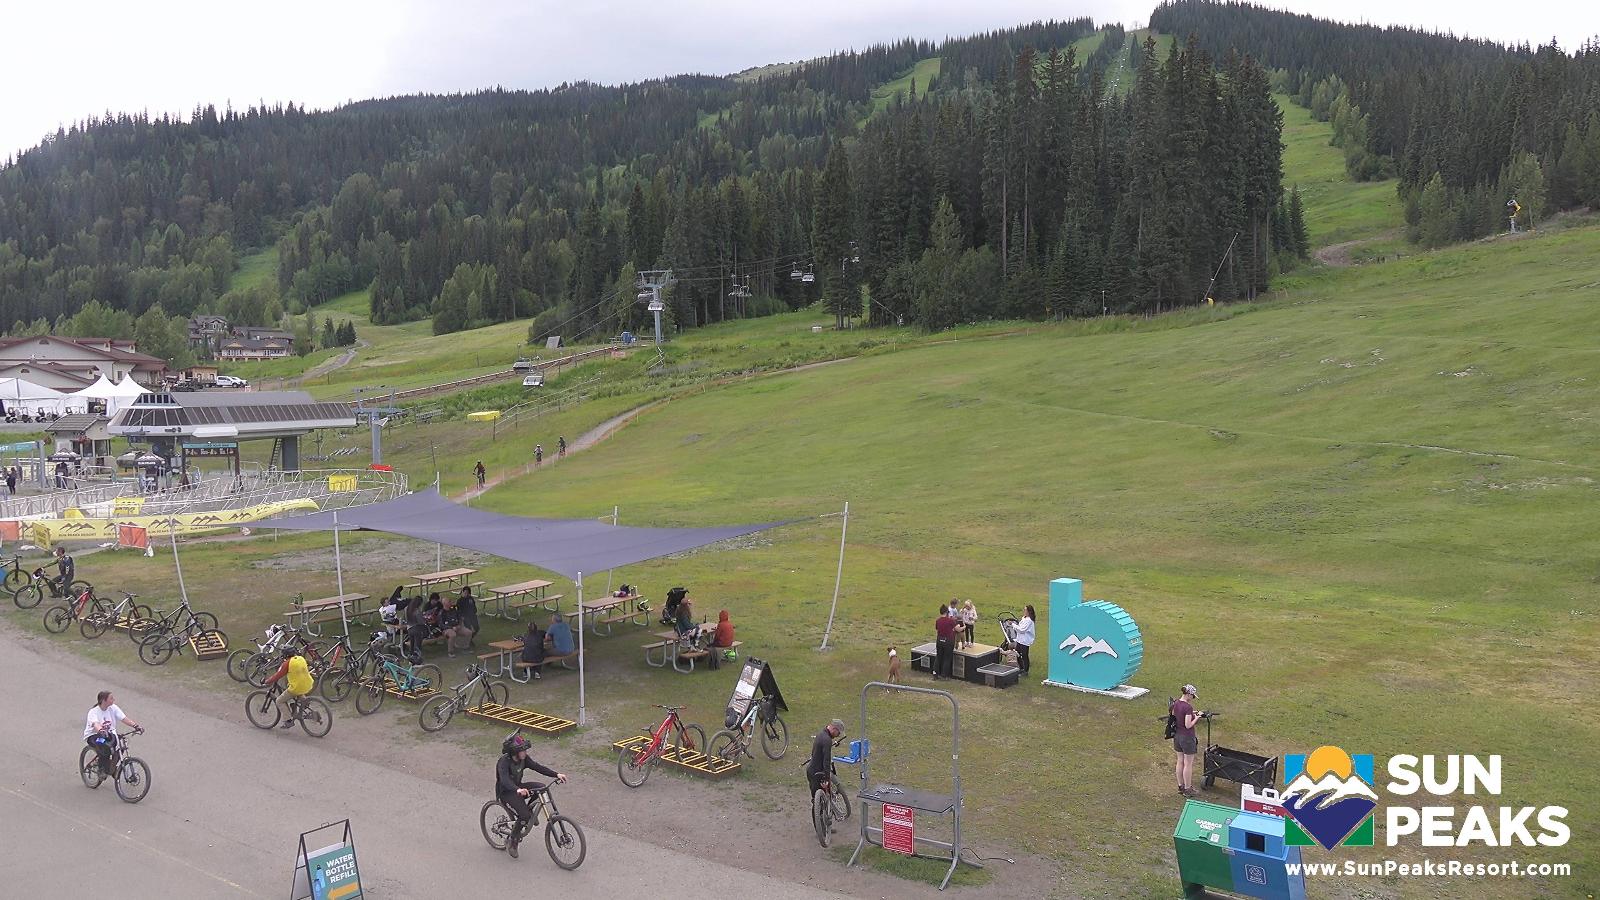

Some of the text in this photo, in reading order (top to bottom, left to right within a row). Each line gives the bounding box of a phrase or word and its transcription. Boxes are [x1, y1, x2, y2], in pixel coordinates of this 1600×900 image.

[326, 854, 353, 868] WATER
[325, 861, 355, 876] BOTTLE
[330, 870, 356, 883] REFILL
